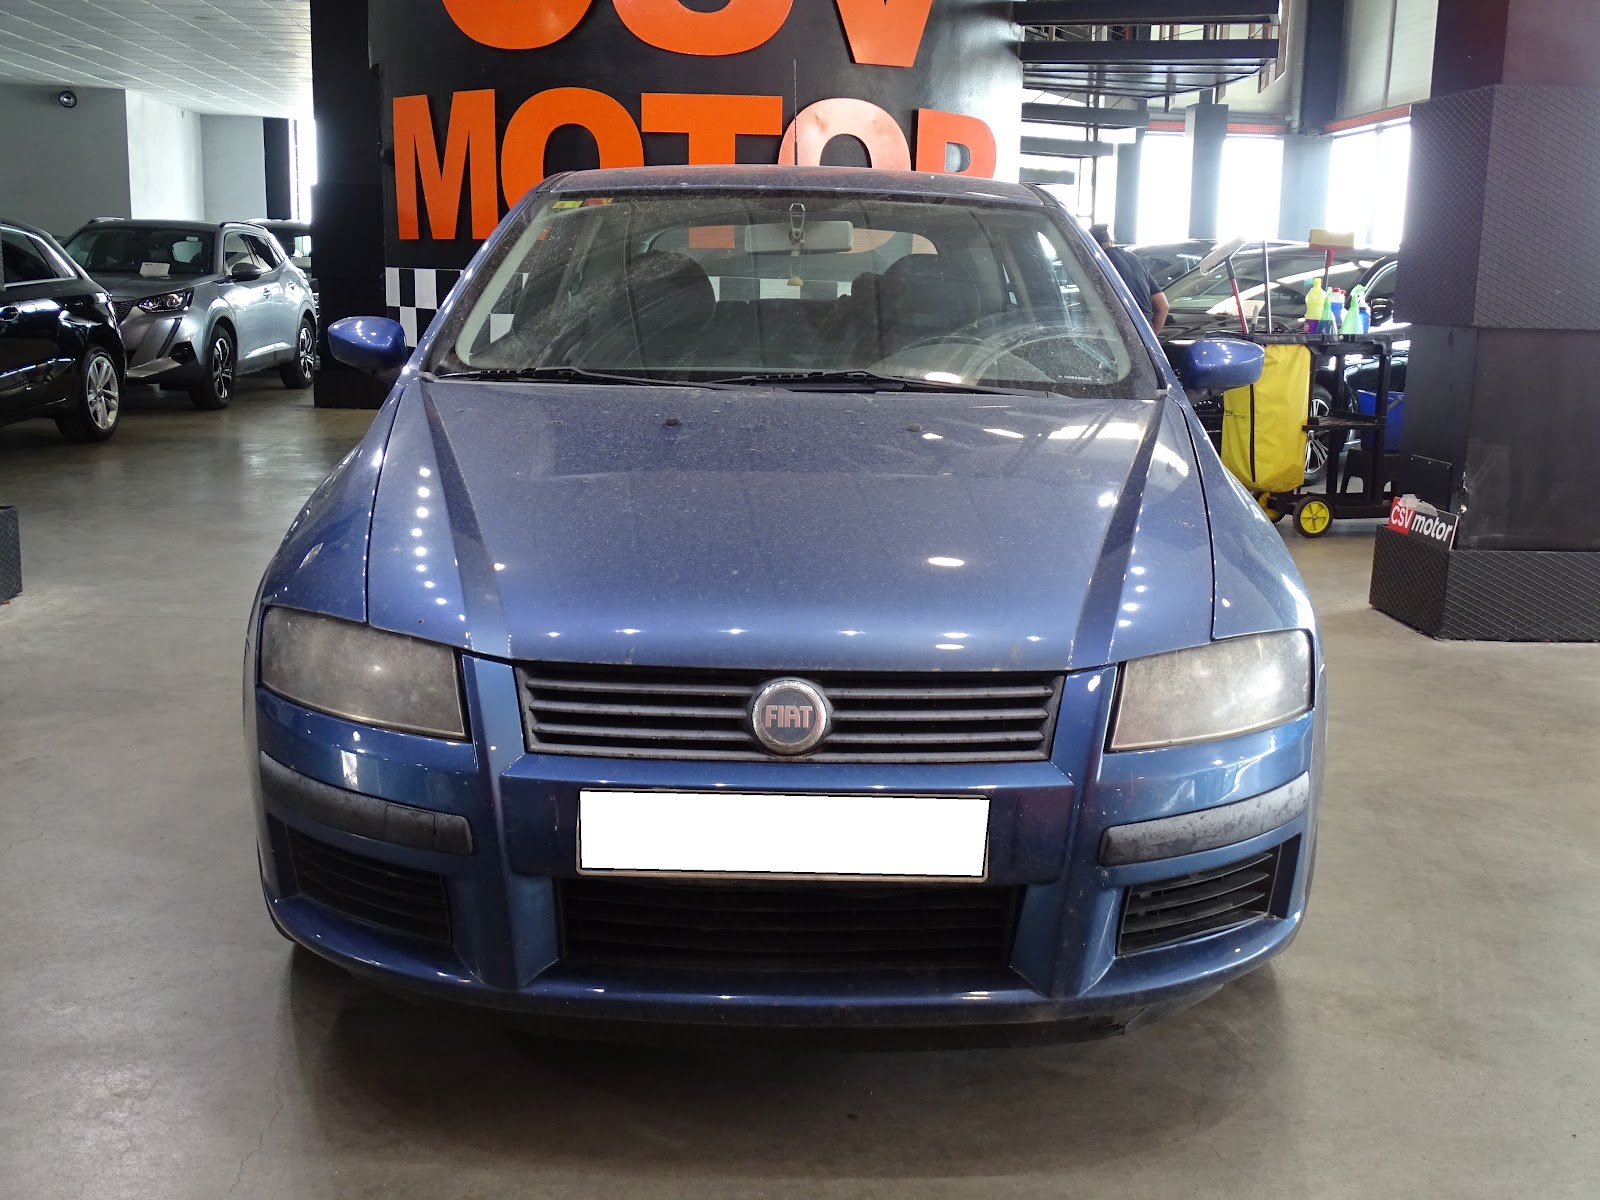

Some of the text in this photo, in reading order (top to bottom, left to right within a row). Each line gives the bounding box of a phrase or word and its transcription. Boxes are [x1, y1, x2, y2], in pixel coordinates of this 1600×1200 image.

[1391, 505, 1453, 541] CSV motor
[765, 705, 812, 728] FIAT
